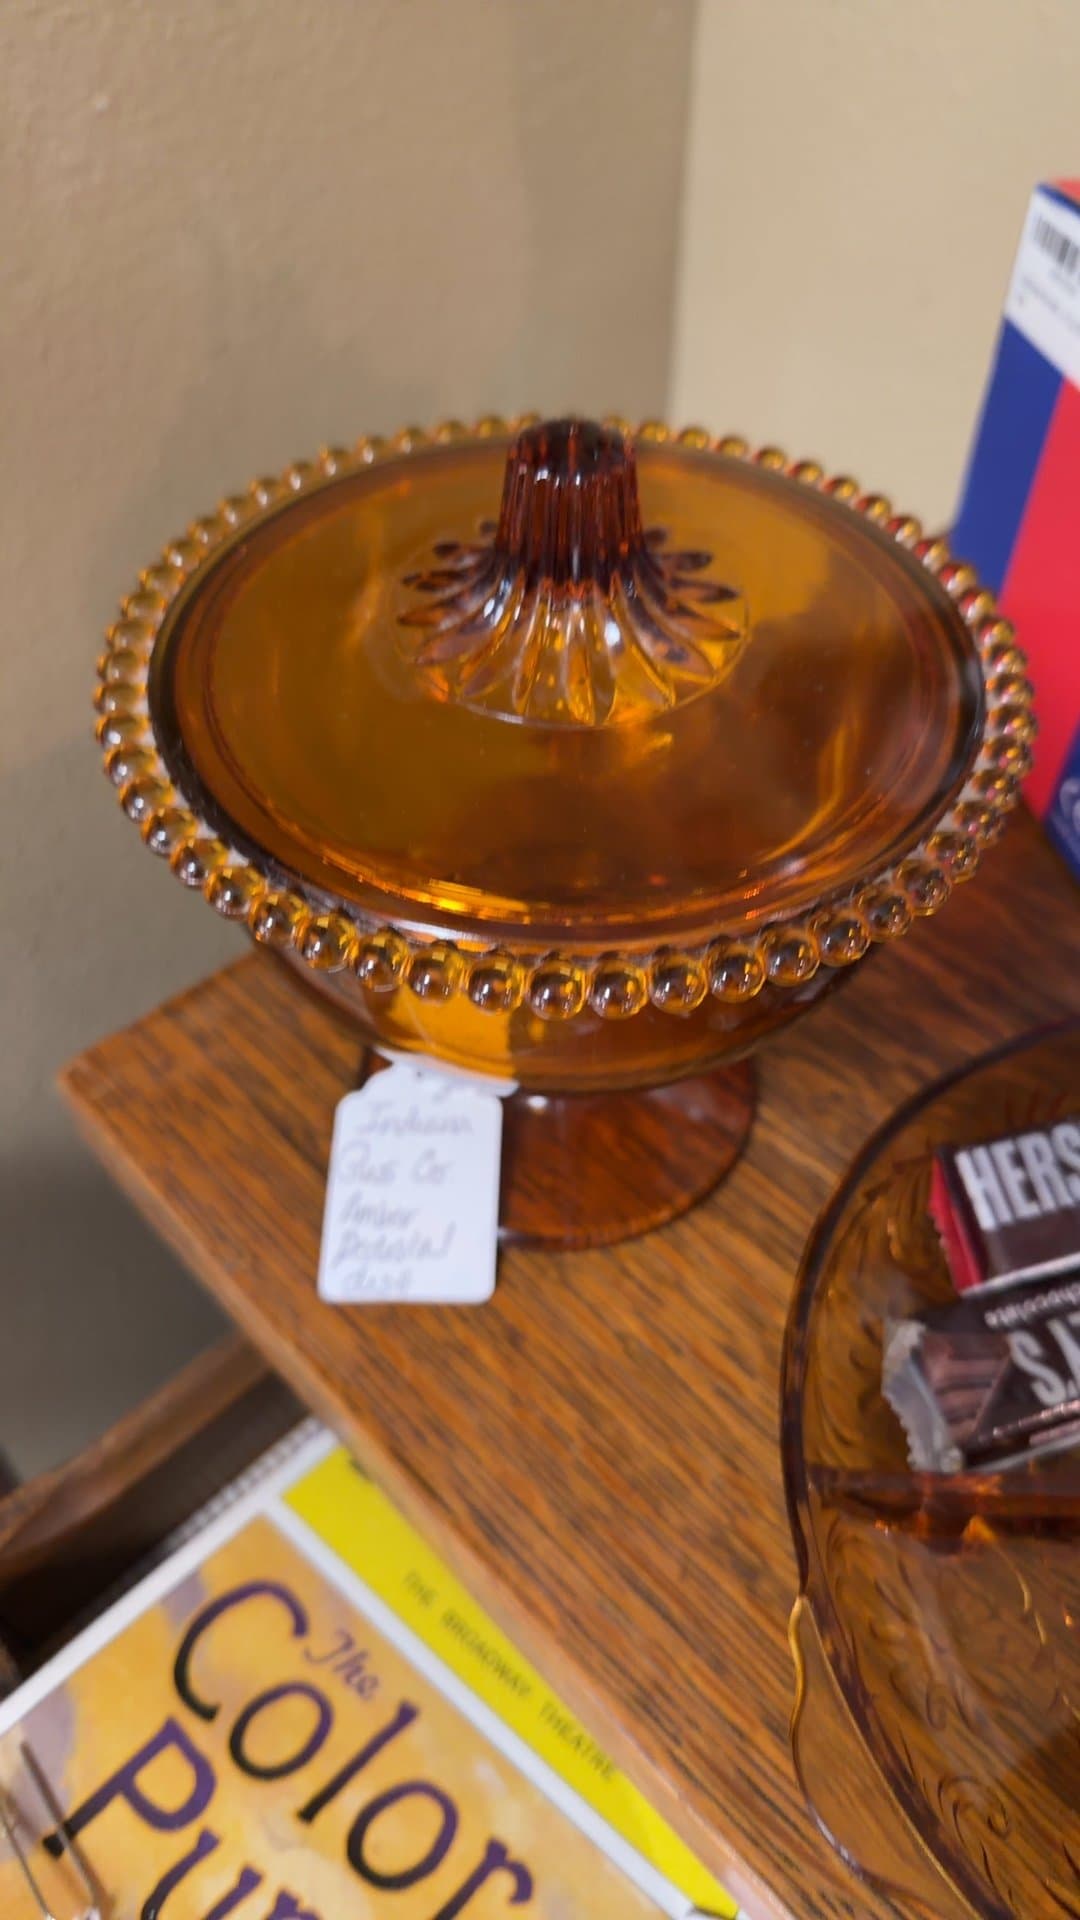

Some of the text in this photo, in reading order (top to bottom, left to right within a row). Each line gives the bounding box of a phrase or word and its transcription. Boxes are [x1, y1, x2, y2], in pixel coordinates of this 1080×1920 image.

[954, 1124, 1080, 1231] HERS
[304, 1627, 380, 1700] The
[403, 1569, 616, 1781] THE BROADWAY THEATRE
[174, 1579, 534, 1920] Color
